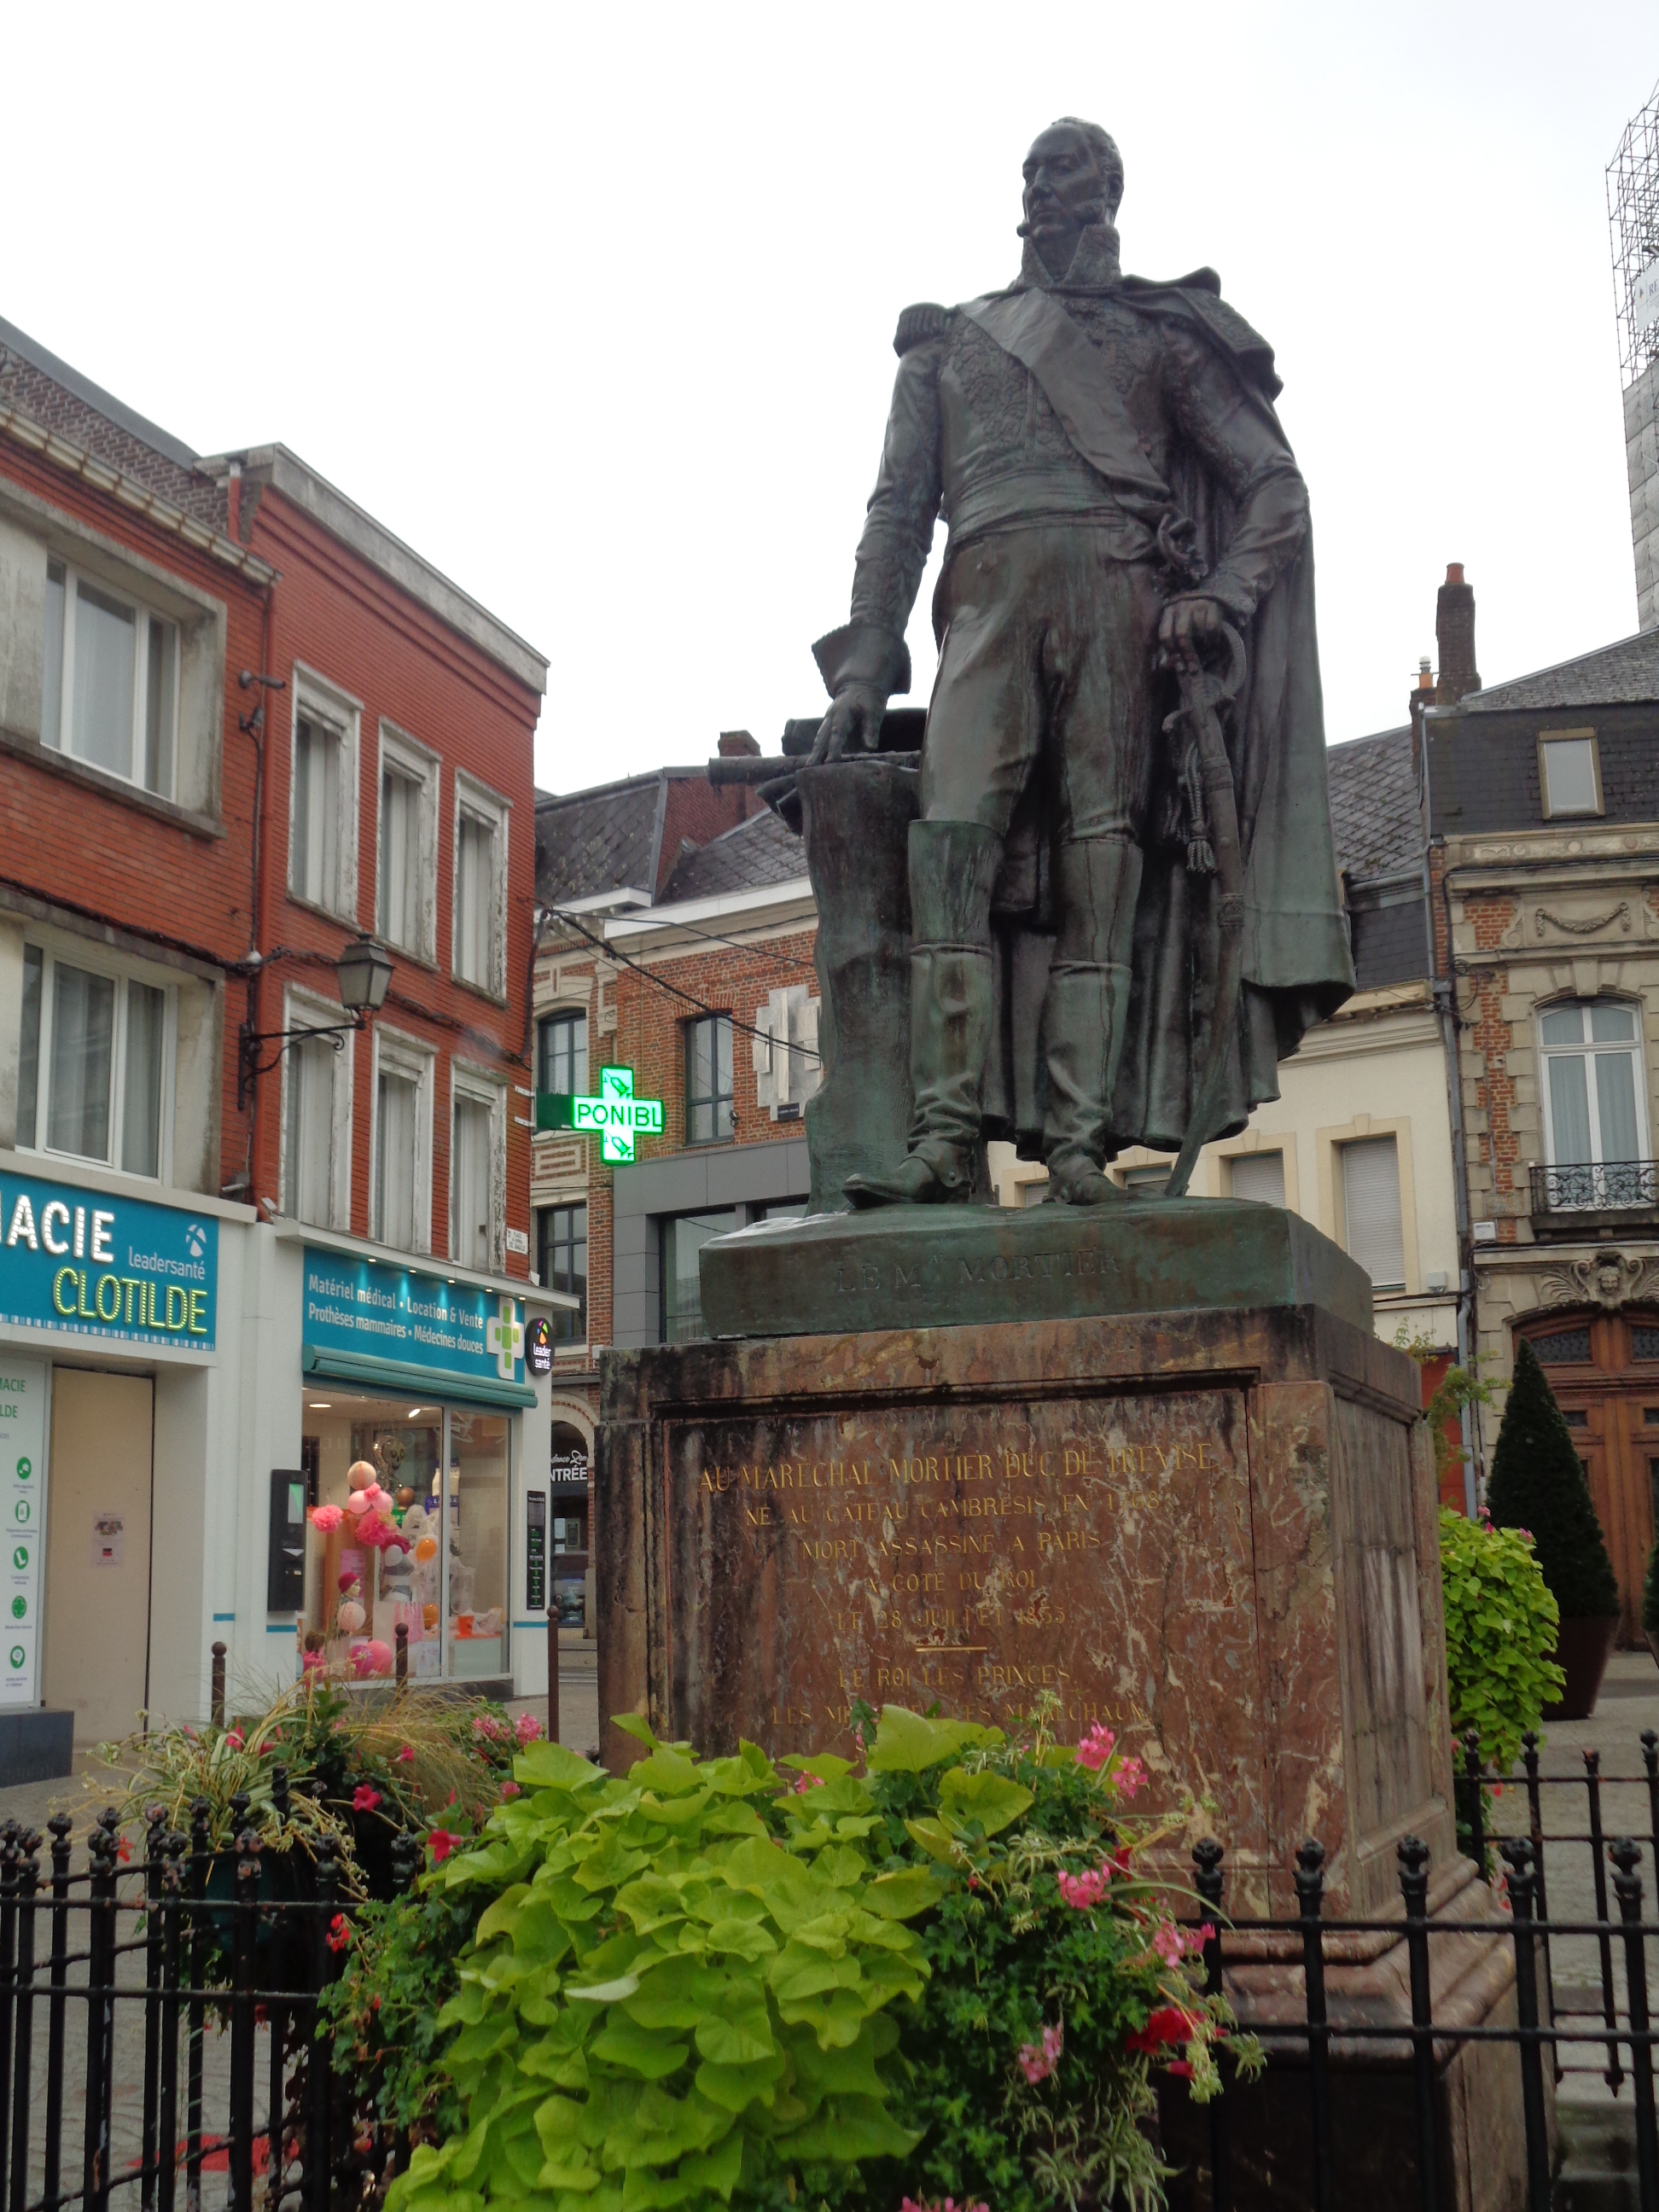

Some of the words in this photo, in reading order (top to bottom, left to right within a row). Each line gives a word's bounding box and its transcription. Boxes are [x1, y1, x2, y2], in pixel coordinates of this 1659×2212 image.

[578, 1103, 662, 1127] PONIBL
[0, 1192, 115, 1263] ACIE
[129, 1246, 205, 1280] Leadersanté
[838, 1266, 881, 1292] LE
[958, 1249, 1121, 1284] MORTIER
[53, 1266, 207, 1334] CLOTILDE
[309, 1274, 354, 1301] Matériel
[358, 1286, 396, 1310] médical
[407, 1296, 448, 1321] Location
[450, 1307, 457, 1323] &
[459, 1308, 484, 1330] Vente
[309, 1302, 355, 1328] Prothèses
[356, 1319, 406, 1338] mammaires
[414, 1324, 456, 1348] Médecines
[457, 1334, 484, 1354] douces
[533, 1342, 551, 1357] Leader
[534, 1358, 550, 1370] santé
[700, 1465, 731, 1493] AU
[740, 1458, 878, 1491] MARÉCHAL
[889, 1453, 993, 1485] MORTIER
[1004, 1451, 1055, 1478] DUC
[1064, 1449, 1097, 1476] DE
[746, 1504, 771, 1527] NÉ
[788, 1505, 814, 1525] AU
[826, 1501, 909, 1523] CATEAU
[1063, 1493, 1090, 1513] EN
[1107, 1491, 1160, 1511] 1768
[802, 1539, 859, 1560] MORT
[1039, 1532, 1101, 1551] PARIS
[959, 1571, 988, 1591] DU
[1000, 1569, 1036, 1590] ROI
[837, 1612, 863, 1630] LE
[877, 1610, 902, 1629] 28
[917, 1607, 1004, 1627] JUILLET
[838, 1668, 865, 1688] LE
[877, 1667, 911, 1688] ROI
[923, 1666, 964, 1686] LES
[771, 1706, 812, 1725] LES
